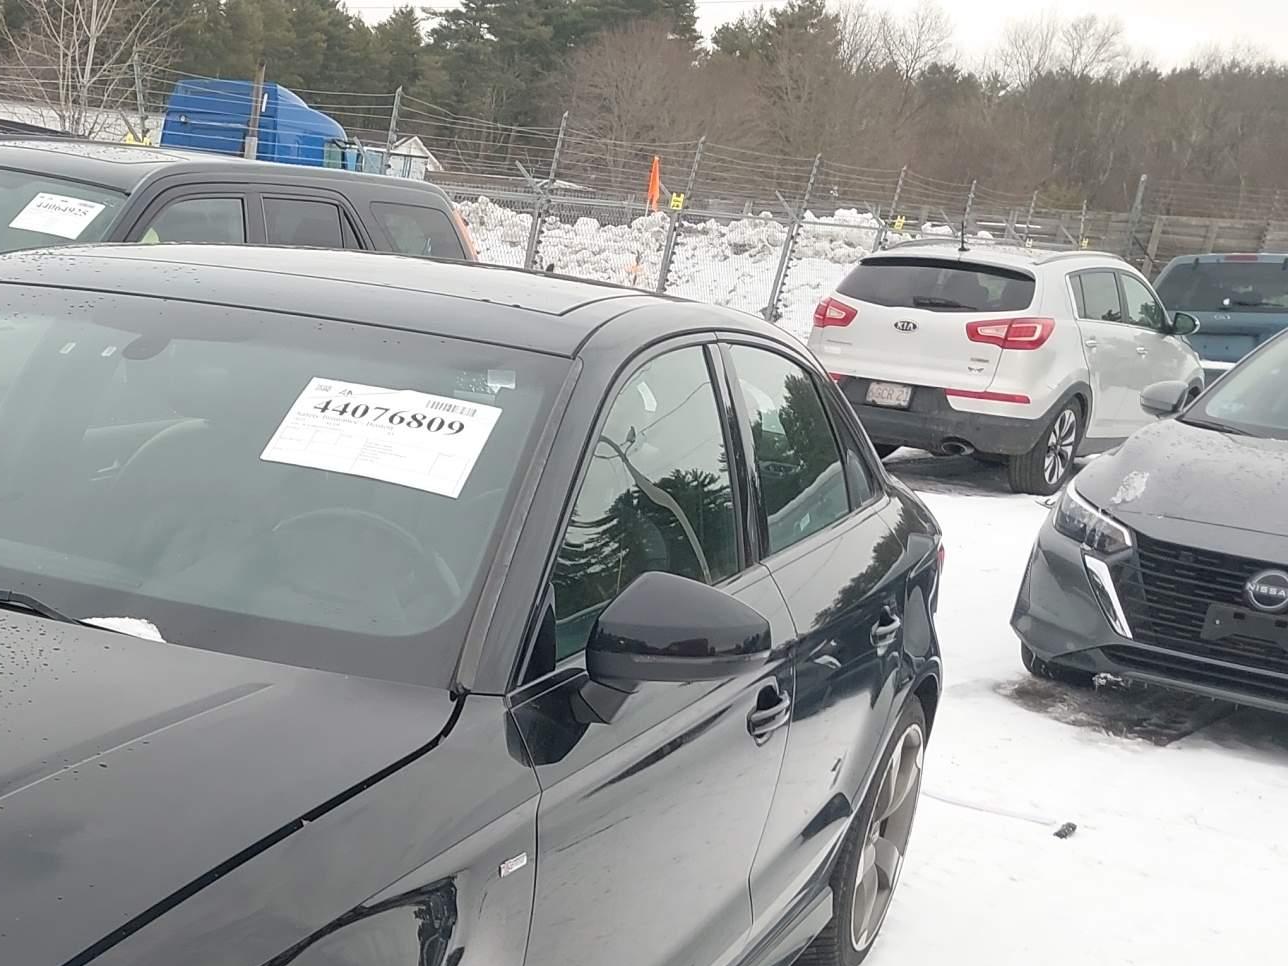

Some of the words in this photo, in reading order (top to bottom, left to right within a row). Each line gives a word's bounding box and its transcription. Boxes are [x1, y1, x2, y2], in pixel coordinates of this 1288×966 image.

[894, 320, 917, 331] KIA
[313, 399, 465, 436] 44076809
[1245, 582, 1288, 598] NISSA
